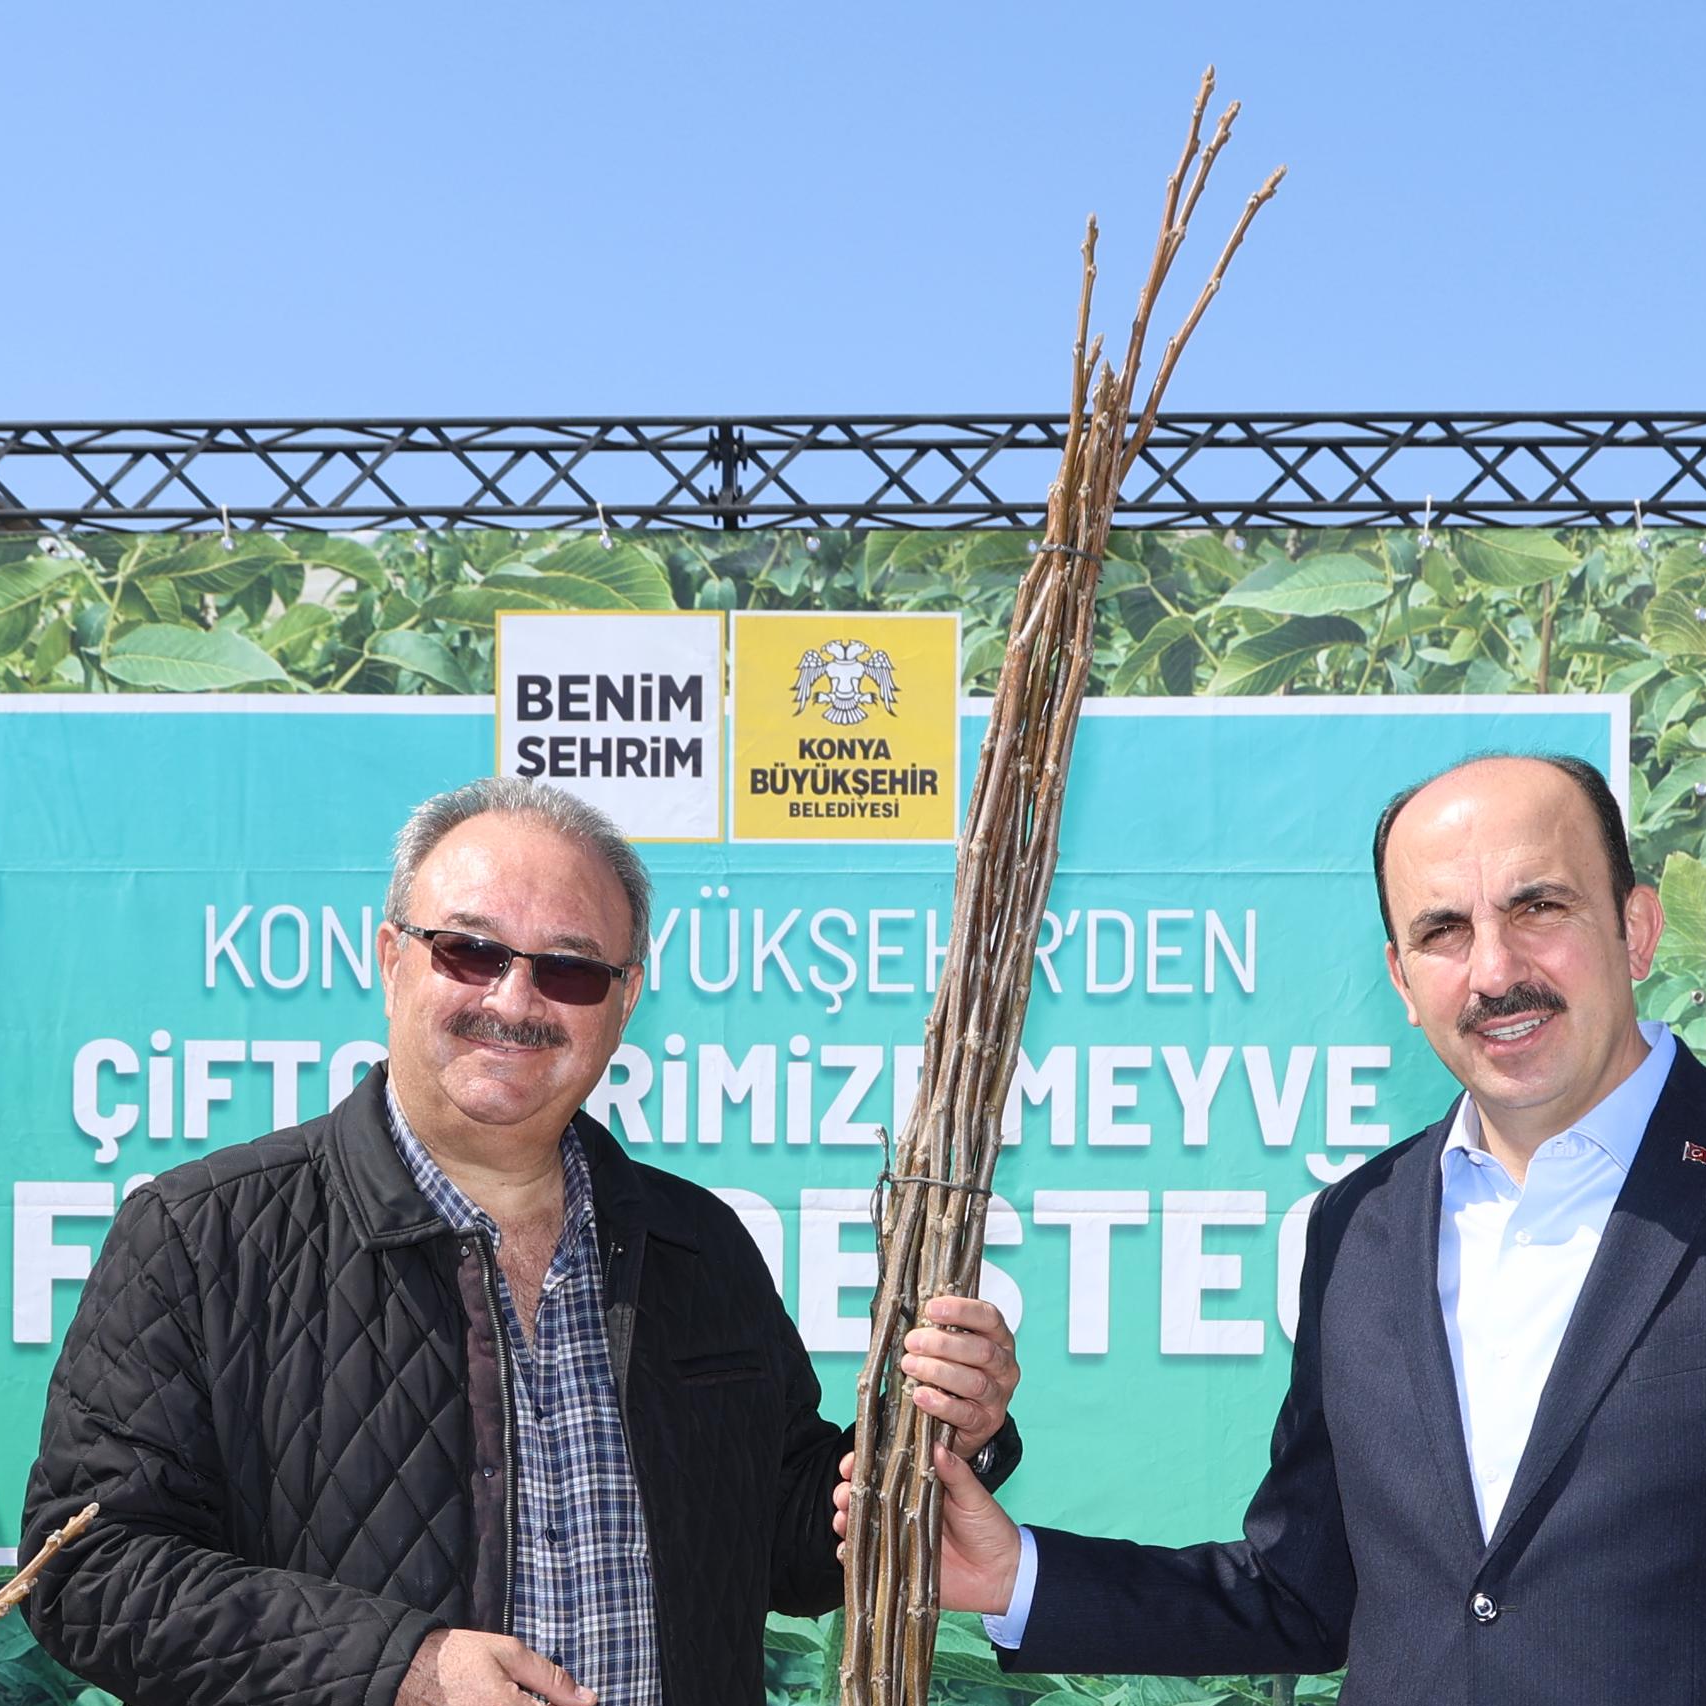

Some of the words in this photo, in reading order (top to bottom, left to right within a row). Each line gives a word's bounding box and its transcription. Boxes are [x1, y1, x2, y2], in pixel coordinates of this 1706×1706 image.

[798, 737, 892, 761] KONYA
[749, 762, 939, 799] BÜYÜKŞEHİR
[788, 797, 900, 819] BELEDİYESİ
[204, 904, 374, 989] KON
[999, 1044, 1391, 1147] MEYVE
